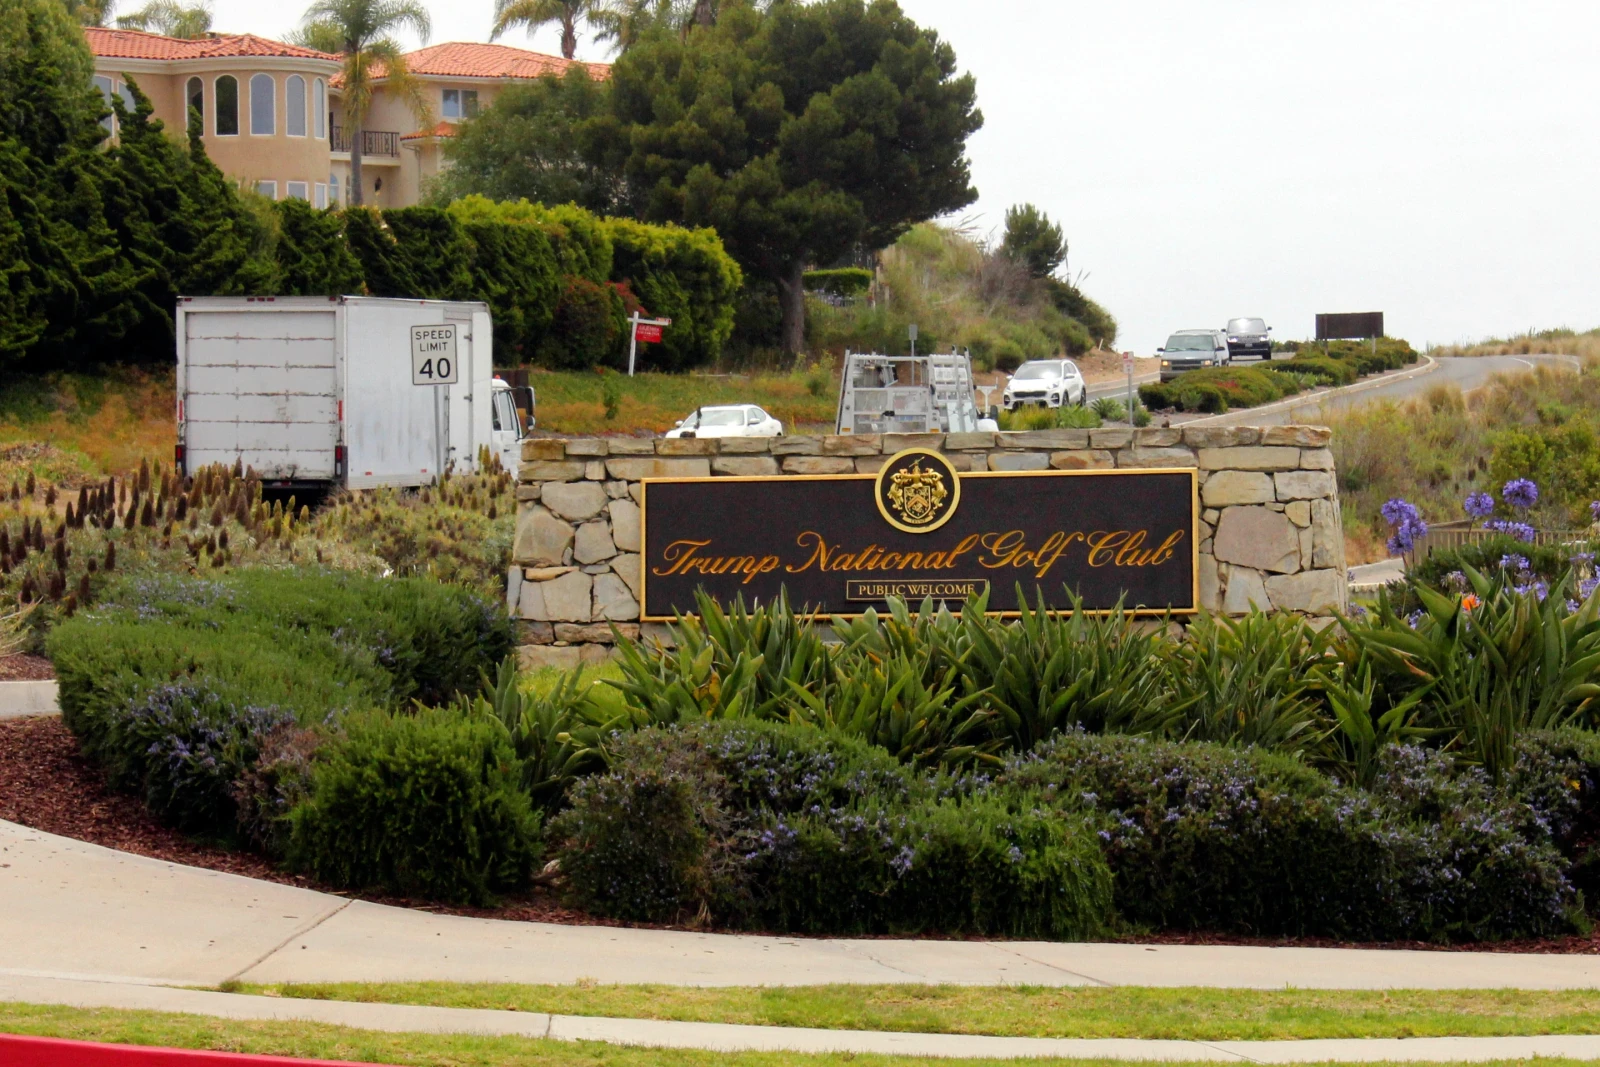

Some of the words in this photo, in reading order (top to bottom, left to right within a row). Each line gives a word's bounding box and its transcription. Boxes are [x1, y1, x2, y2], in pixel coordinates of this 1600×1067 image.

[415, 330, 452, 340] SPEED
[420, 342, 448, 352] LIMIT
[419, 358, 451, 378] 40
[653, 539, 780, 584] Trump
[786, 531, 980, 572] National
[979, 530, 1084, 578] Golf
[1087, 529, 1185, 567] Club
[859, 584, 906, 595] PUBLIC
[907, 584, 975, 595] WELCOME
